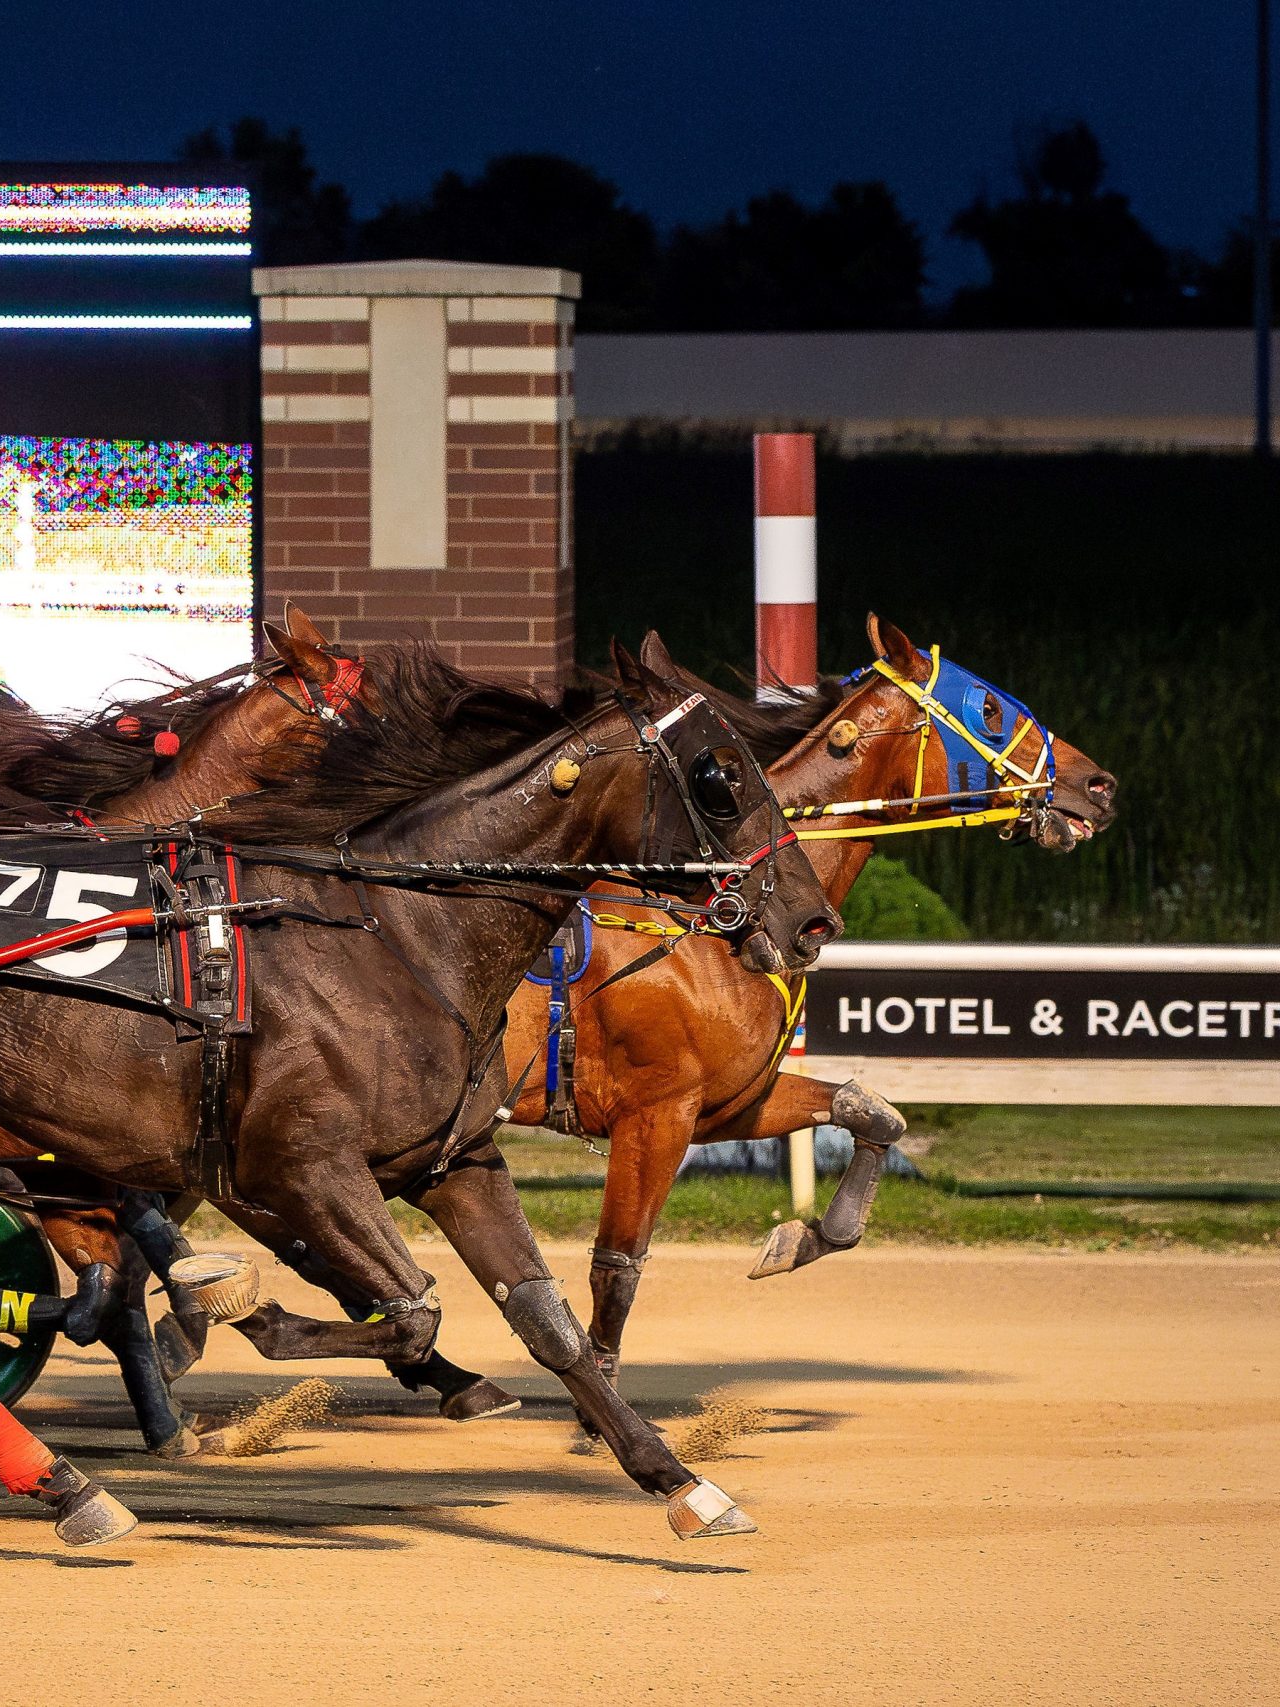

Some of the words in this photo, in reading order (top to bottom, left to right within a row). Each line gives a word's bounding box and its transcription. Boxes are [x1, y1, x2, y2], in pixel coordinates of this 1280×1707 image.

[28, 869, 140, 978] 5
[838, 996, 1011, 1036] HOTEL
[1030, 998, 1064, 1037] &
[0, 1289, 37, 1333] N
